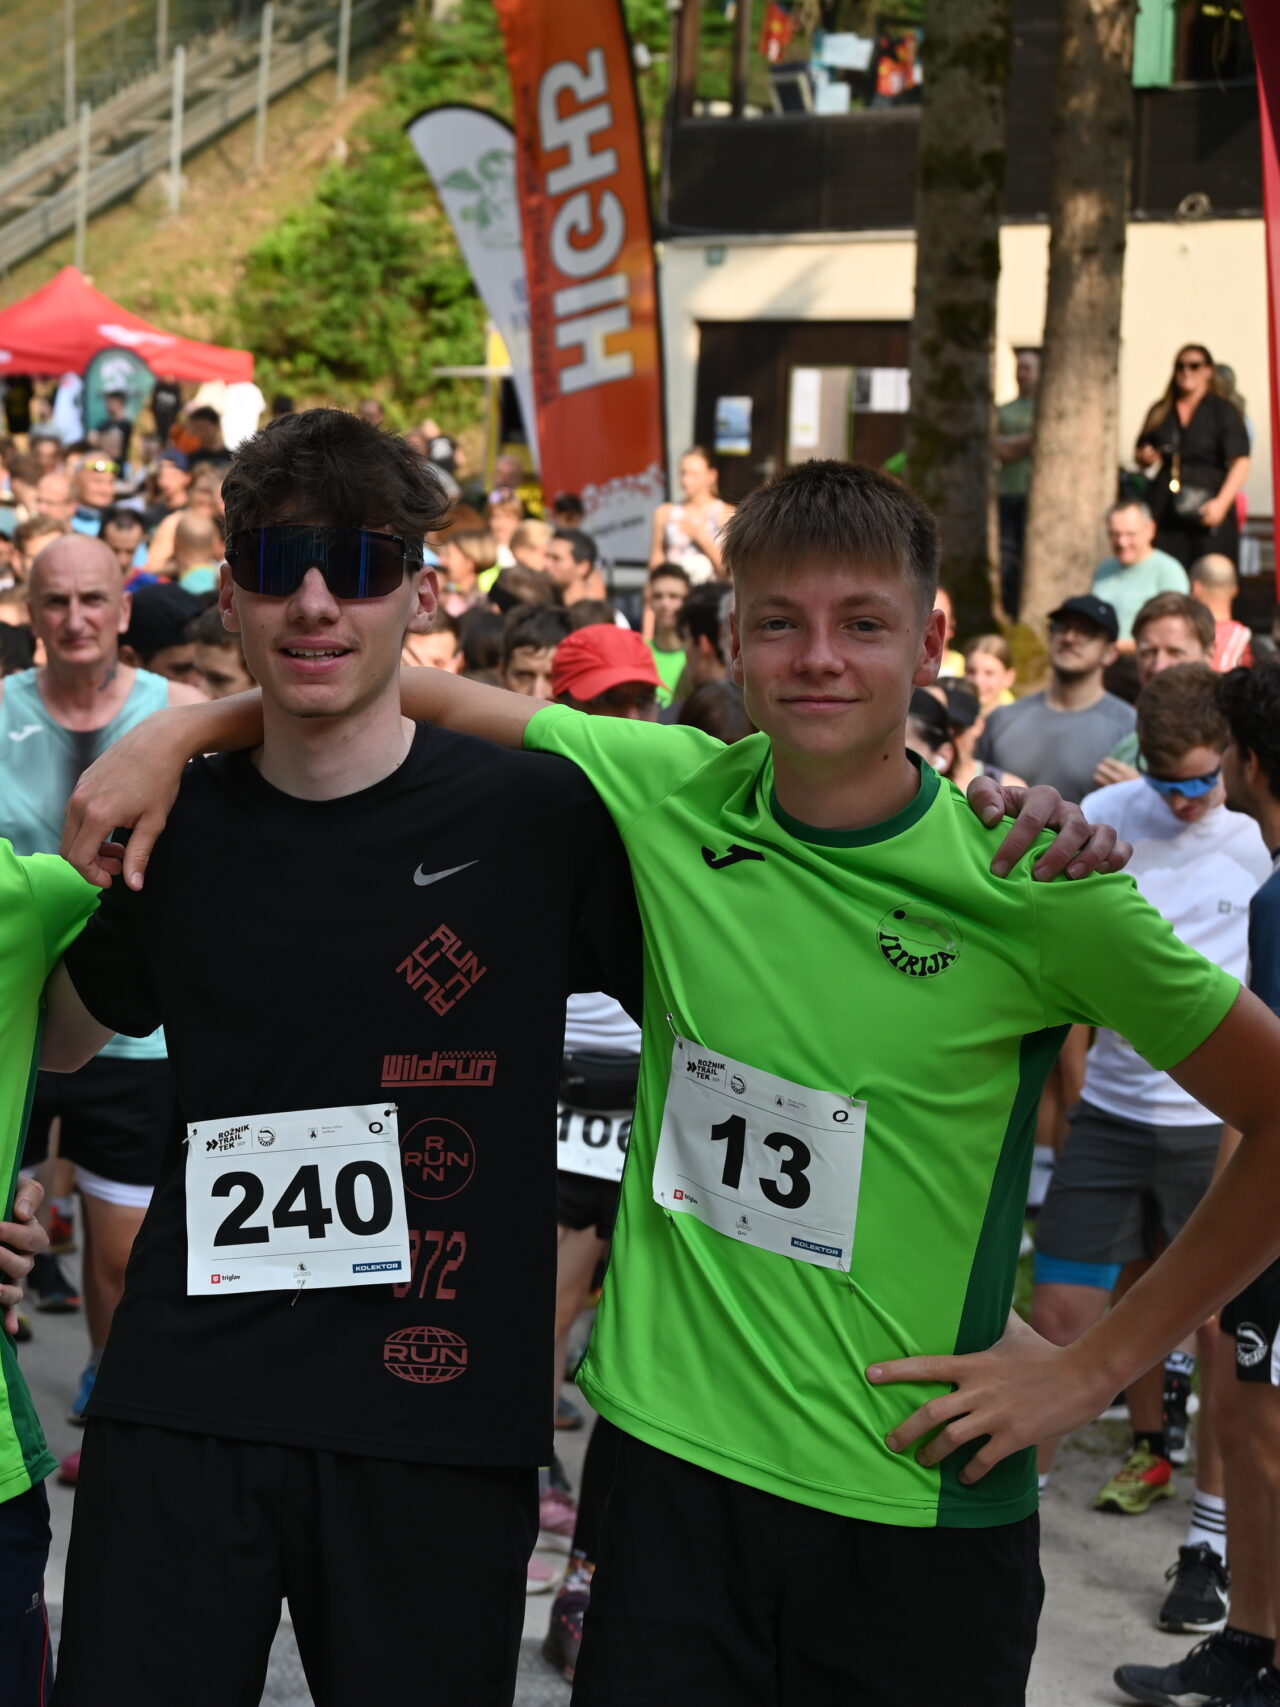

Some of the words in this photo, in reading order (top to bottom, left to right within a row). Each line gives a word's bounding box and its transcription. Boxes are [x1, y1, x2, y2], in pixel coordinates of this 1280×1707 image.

[696, 1072, 710, 1081] TEK
[697, 1066, 718, 1076] TRAIL
[218, 1133, 243, 1145] TRAIL
[219, 1142, 235, 1151] TEK
[711, 1114, 811, 1209] 13
[211, 1160, 394, 1247] 240
[793, 1240, 839, 1256] KOLEKTOR
[355, 1263, 398, 1271] KOLEKTOR
[383, 1344, 468, 1364] RUN
